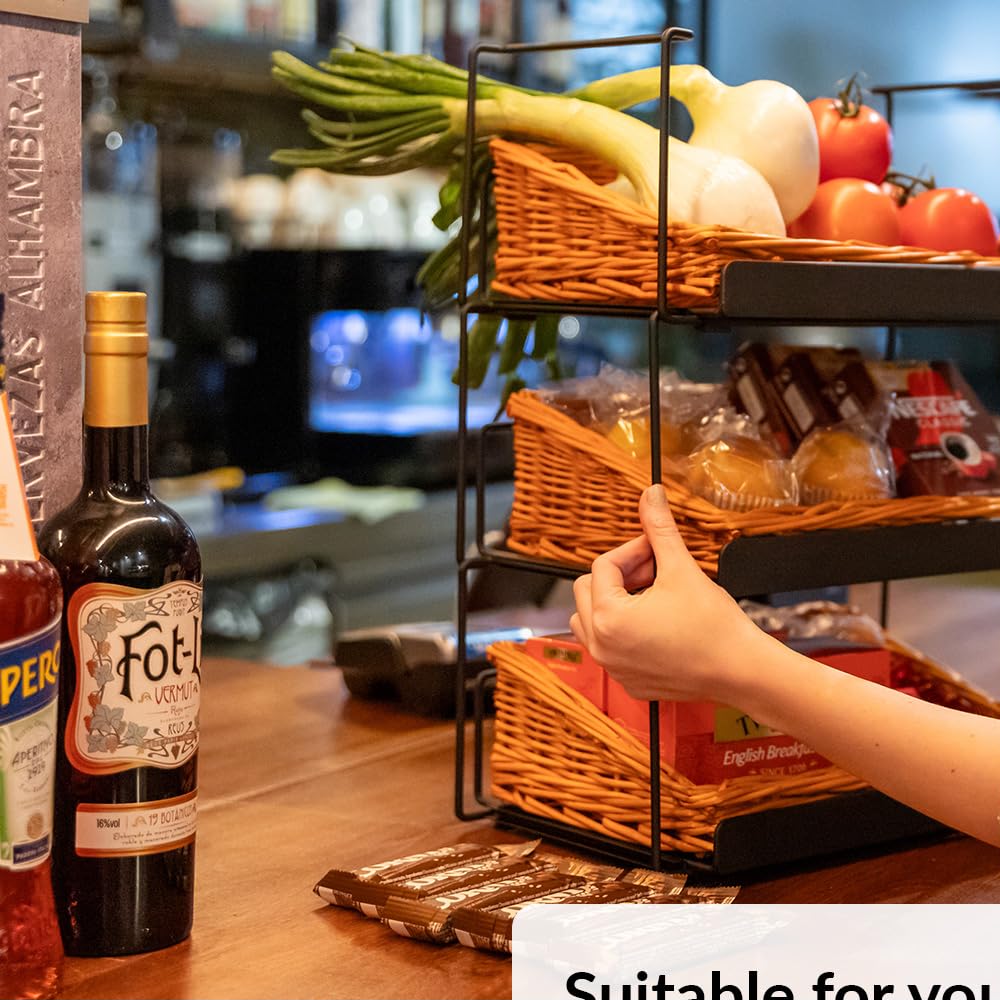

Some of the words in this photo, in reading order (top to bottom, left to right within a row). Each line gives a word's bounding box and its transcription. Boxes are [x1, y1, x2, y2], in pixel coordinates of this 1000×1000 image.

[7, 69, 45, 312] ALHAMBRA
[154, 681, 194, 704] VERMUT
[723, 746, 766, 767] English
